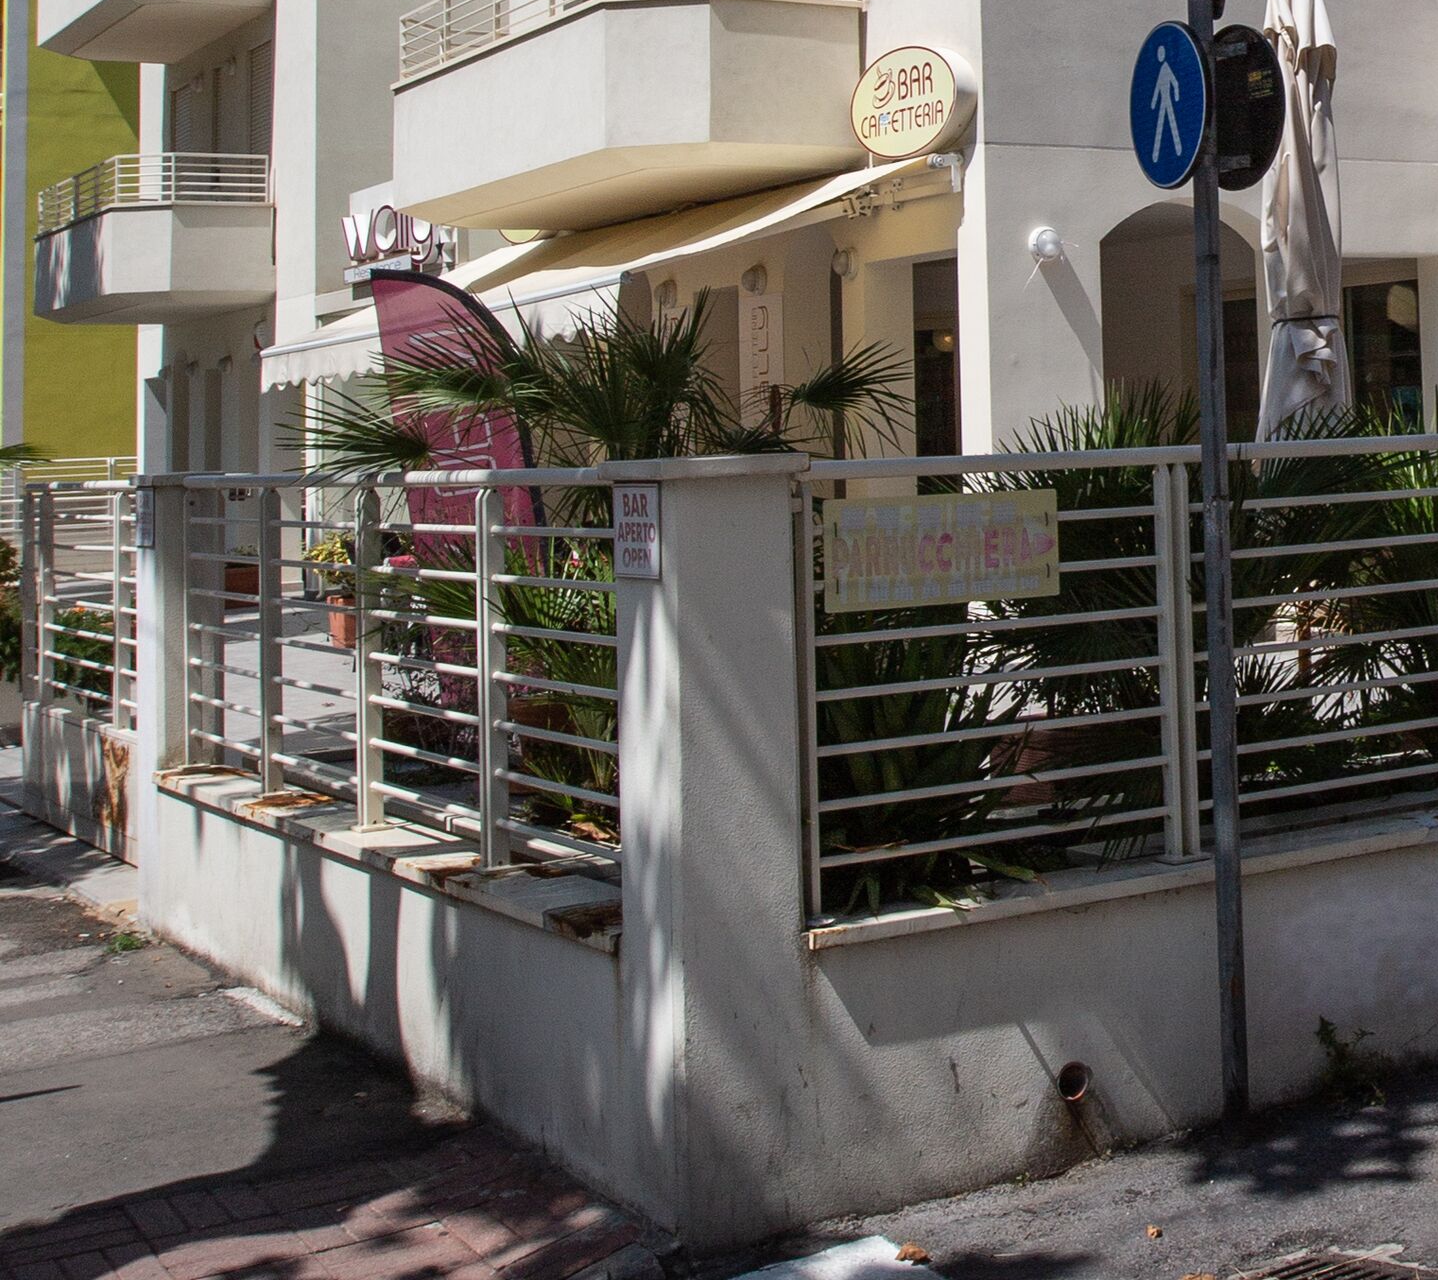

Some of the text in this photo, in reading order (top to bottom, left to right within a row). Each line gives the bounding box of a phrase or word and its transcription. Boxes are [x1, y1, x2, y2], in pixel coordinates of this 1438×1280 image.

[897, 62, 933, 101] BAR
[354, 260, 401, 279] Resence
[622, 493, 649, 518] BAR
[617, 522, 656, 543] APERTO
[622, 547, 653, 568] OPEN
